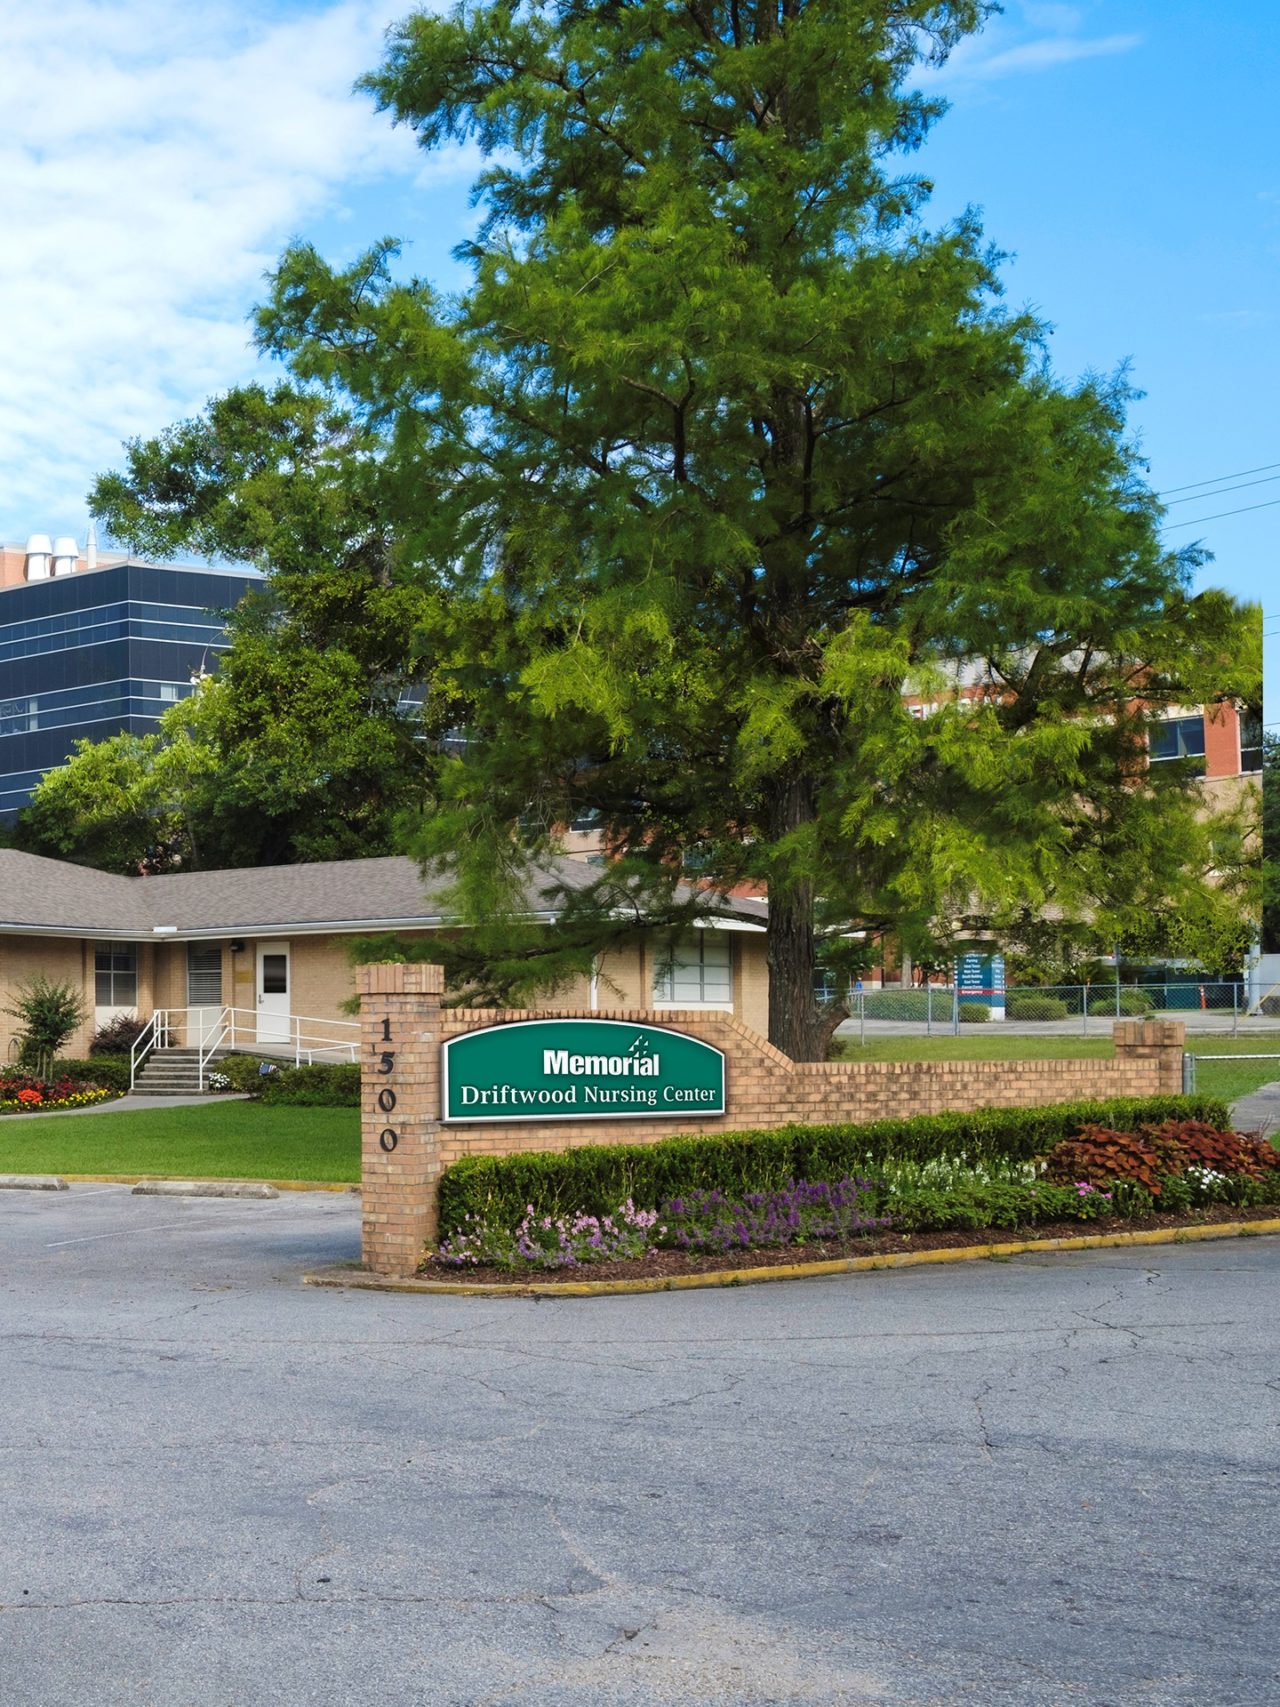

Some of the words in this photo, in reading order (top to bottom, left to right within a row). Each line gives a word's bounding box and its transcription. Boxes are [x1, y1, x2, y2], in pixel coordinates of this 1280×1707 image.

[543, 1050, 660, 1076] Memorial
[378, 1018, 398, 1152] 1500
[461, 1085, 577, 1105] Driftwood
[584, 1086, 657, 1105] Nursing
[663, 1086, 716, 1102] Center
